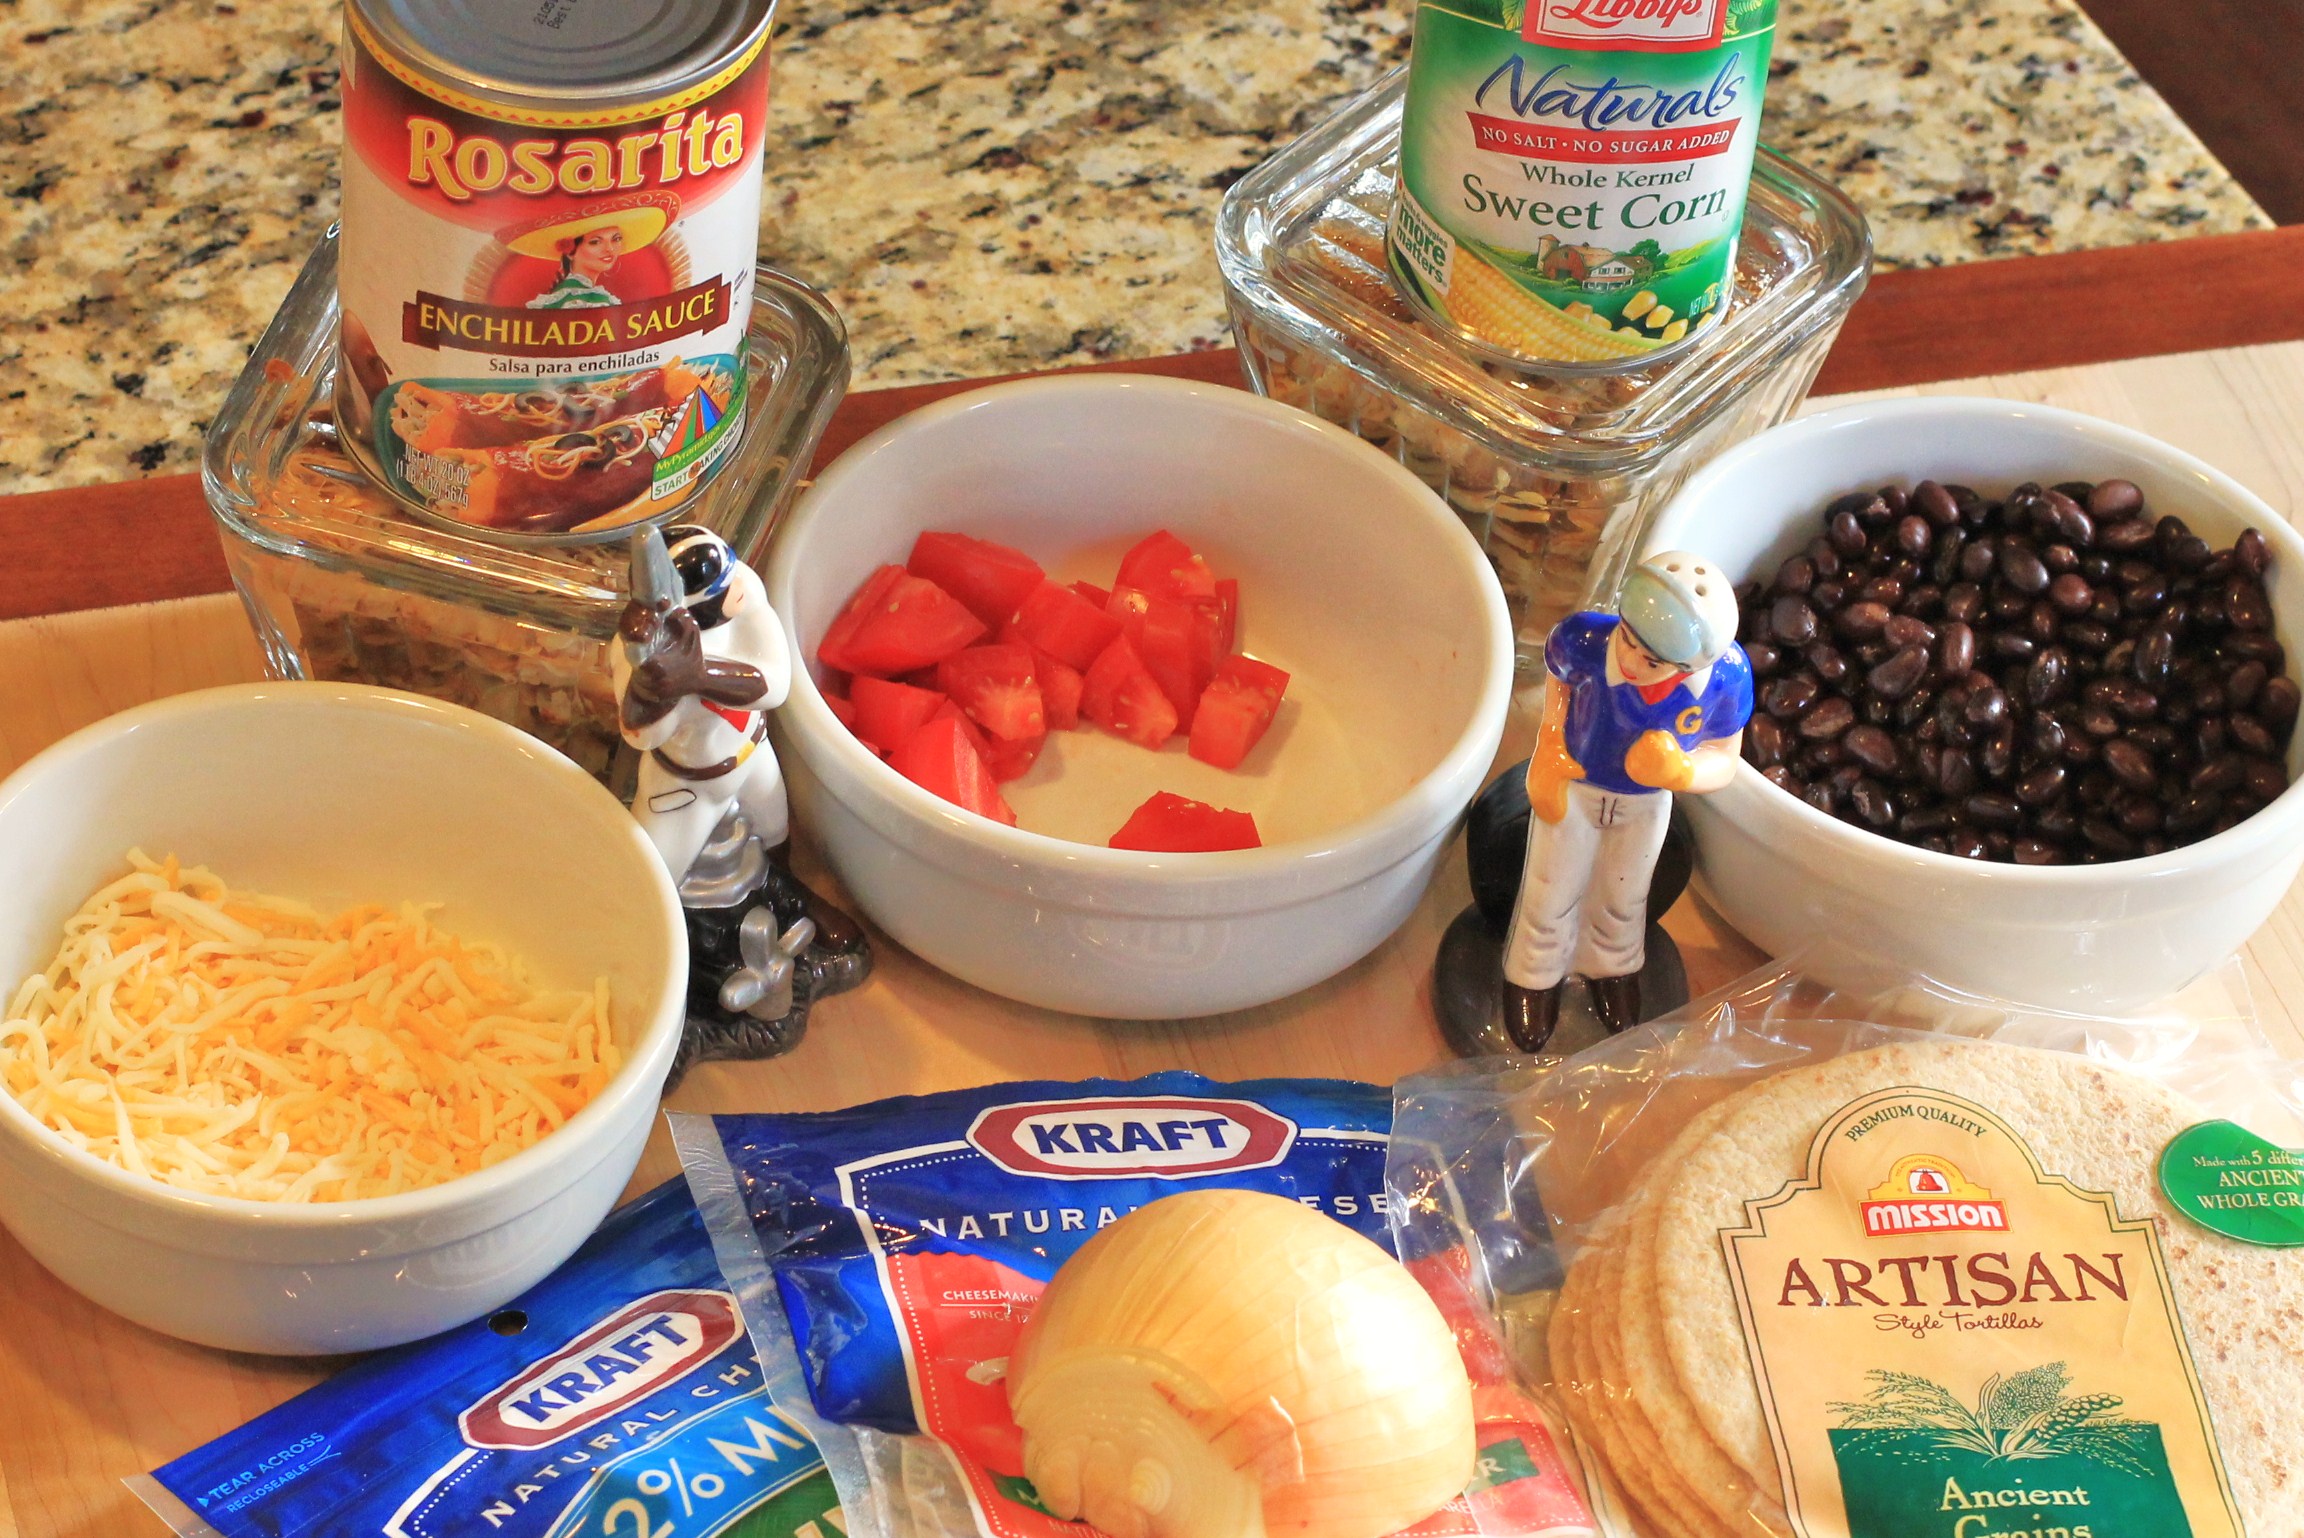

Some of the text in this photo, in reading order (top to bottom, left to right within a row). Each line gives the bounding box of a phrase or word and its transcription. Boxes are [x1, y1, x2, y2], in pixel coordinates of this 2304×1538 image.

[1475, 51, 1745, 132] Naturals
[407, 112, 744, 200] Rosarita
[1482, 126, 1731, 154] NO SALT NO SUGAR ADDED
[1521, 162, 1695, 189] Whole Kernel
[1463, 173, 1727, 231] Sweet Corn
[1396, 225, 1444, 284] matters
[1399, 203, 1447, 267] more
[419, 288, 716, 348] ENCHILADA SAUCE
[489, 351, 660, 377] Salsa para enchiladas
[405, 443, 470, 487] NET WT 20 OZ
[405, 463, 416, 485] LB
[418, 472, 425, 489] 4
[427, 476, 442, 500] OZ)
[444, 483, 469, 511] 567g
[654, 472, 689, 497] START
[1675, 706, 1703, 735] G
[1030, 1117, 1229, 1154] KRAFT
[1845, 1104, 1987, 1142] PREMIUM QUALITY
[2192, 1156, 2227, 1168] Made
[2227, 1154, 2251, 1167] with
[2251, 1149, 2263, 1166] 5
[919, 1205, 1140, 1241] NATURA
[2197, 1192, 2271, 1210] WHOLE
[1776, 1251, 2129, 1310] ARTISAN
[968, 1310, 1013, 1322] SINCE
[1873, 1310, 2045, 1340] Style Tortillas
[508, 1314, 689, 1424] KRAFT
[208, 1432, 326, 1500] TEAR ACROSS
[226, 1463, 310, 1513] RECLOSEABLE
[480, 1408, 680, 1529] NATURAL
[603, 1458, 726, 1538] 2%
[1939, 1475, 2091, 1511] Ancient
